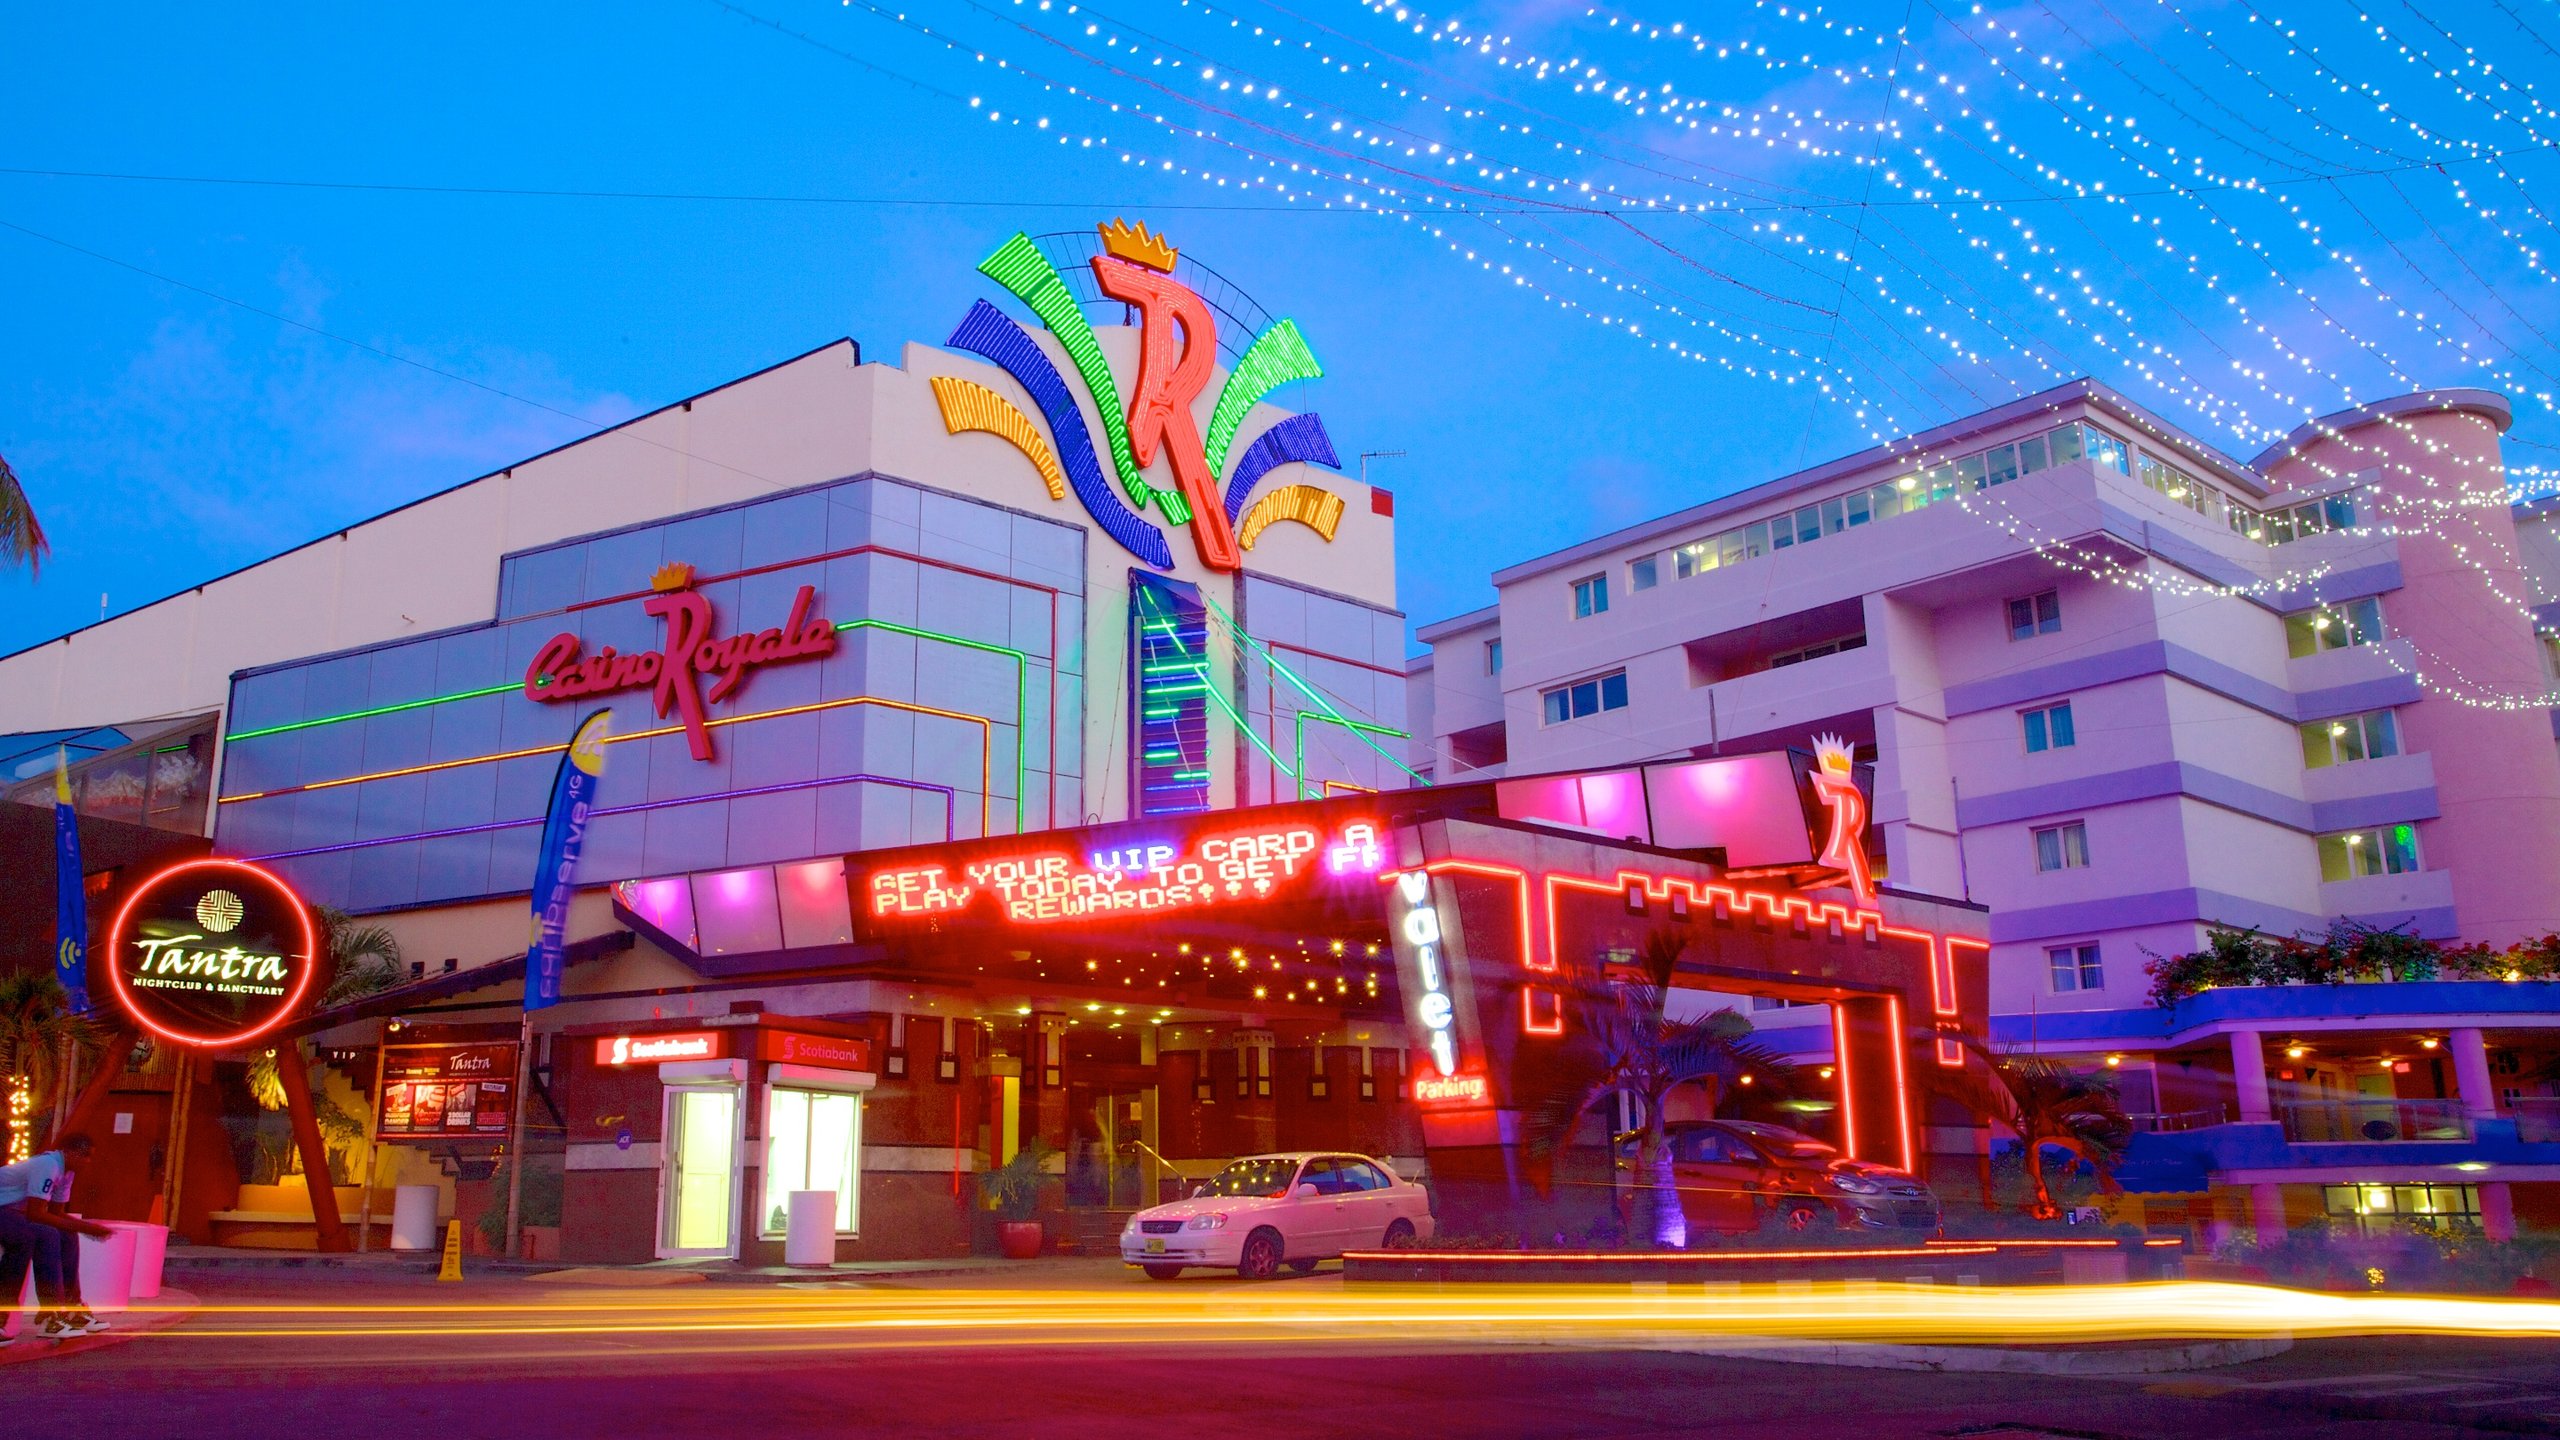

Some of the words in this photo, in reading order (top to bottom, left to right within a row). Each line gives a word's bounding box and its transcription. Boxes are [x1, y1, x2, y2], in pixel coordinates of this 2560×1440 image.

[1089, 255, 1241, 574] R
[524, 632, 665, 702] Casino
[643, 585, 836, 761] Royale
[568, 774, 583, 799] 4G
[1808, 769, 1879, 911] R
[874, 869, 943, 892] GET
[968, 856, 1068, 885] YOUR
[1094, 846, 1174, 871] VIP
[1201, 830, 1314, 861] CARD
[1345, 824, 1375, 847] A
[876, 885, 970, 913] PLAY
[996, 871, 1122, 901] TODAY
[1149, 863, 1203, 887] TO
[1218, 853, 1301, 880] GET
[137, 935, 288, 981] Tantra
[133, 978, 202, 990] NIGHTCLUB
[205, 983, 214, 991] &
[217, 984, 285, 996] SANCTUARY
[450, 1052, 492, 1070] Tantra
[632, 1038, 708, 1057] Scotiabank
[800, 1043, 859, 1062] Scotiabank
[1416, 1077, 1483, 1099] Parking
